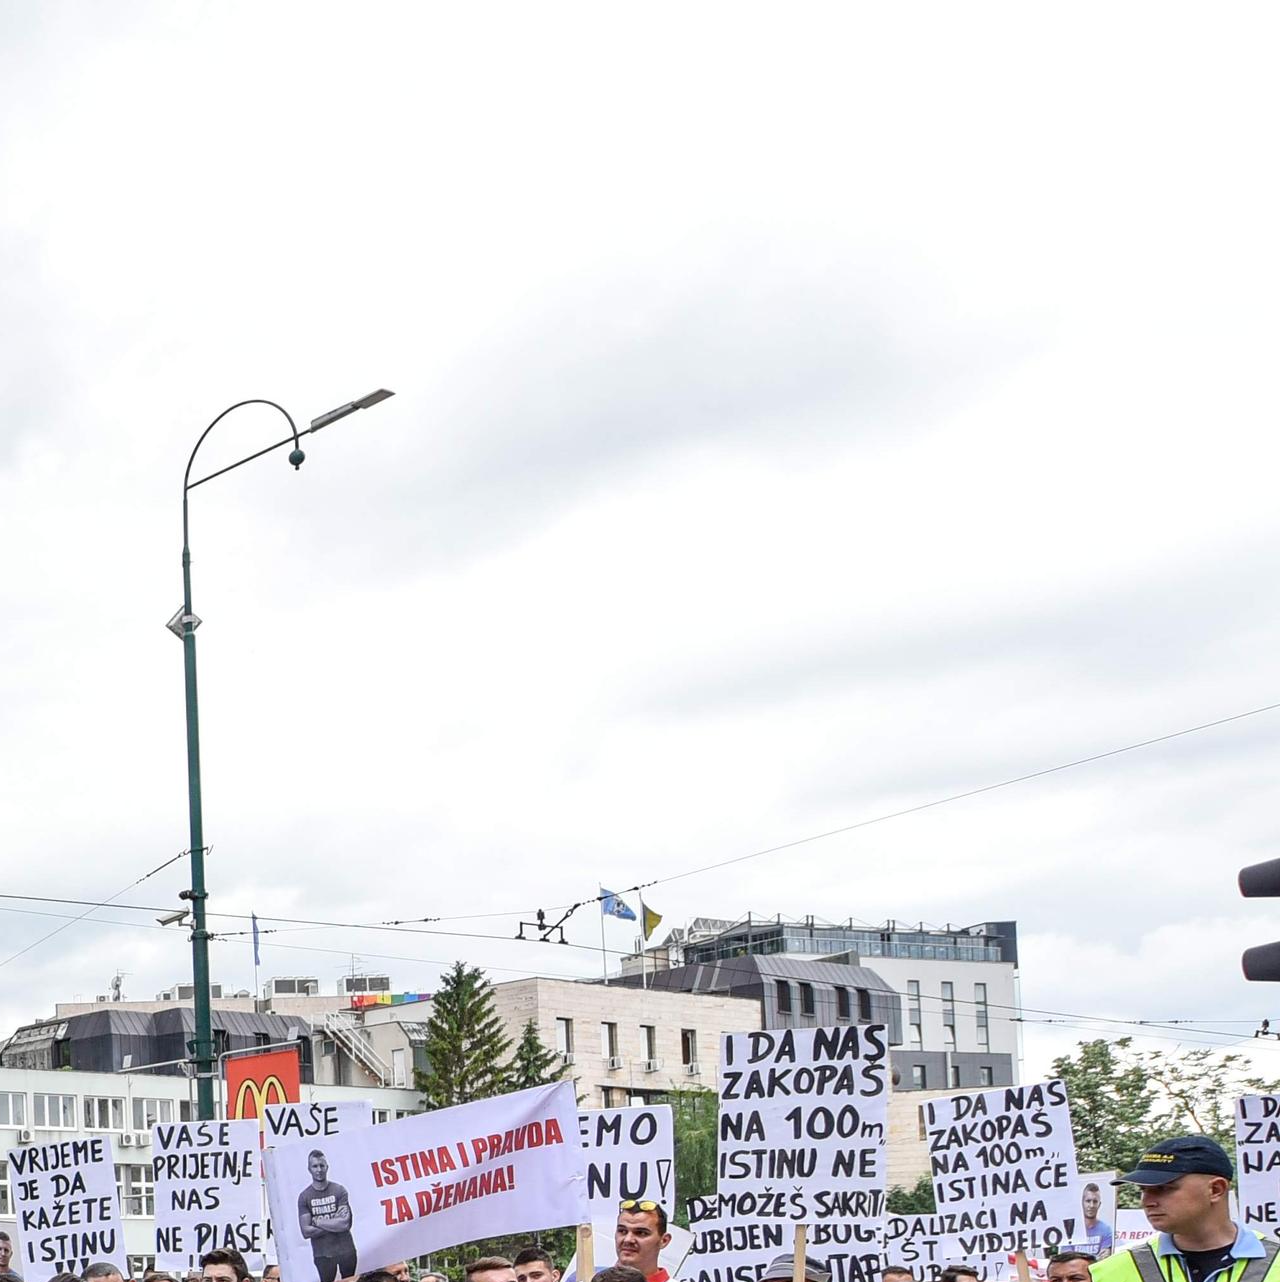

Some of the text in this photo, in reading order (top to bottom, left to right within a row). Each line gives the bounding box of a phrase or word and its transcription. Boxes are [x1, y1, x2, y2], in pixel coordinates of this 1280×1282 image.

[726, 1024, 886, 1066] I DA NAS
[721, 1060, 885, 1100] ZAKOPAŠ
[927, 1080, 1067, 1126] I DA NAS
[265, 1103, 340, 1138] VAŠE
[721, 1111, 765, 1142] NA
[928, 1108, 1053, 1152] ZAKOPAŠ
[9, 1139, 104, 1176] VRIJEME
[371, 1118, 563, 1187] ISTINA I PRAVDA
[720, 1148, 876, 1179] ISTINU NE
[931, 1152, 969, 1177] NA
[17, 1172, 87, 1201] JE DA
[381, 1165, 515, 1227] ZA DŽENANA!
[938, 1160, 1068, 1203] ISTINA ĆE
[22, 1197, 112, 1231] KAŽETE
[172, 1187, 220, 1211] NAS
[718, 1186, 808, 1220] MOŽEŠ
[1010, 1200, 1048, 1226] NA
[28, 1229, 116, 1263] ISTINU
[157, 1226, 182, 1253] NE
